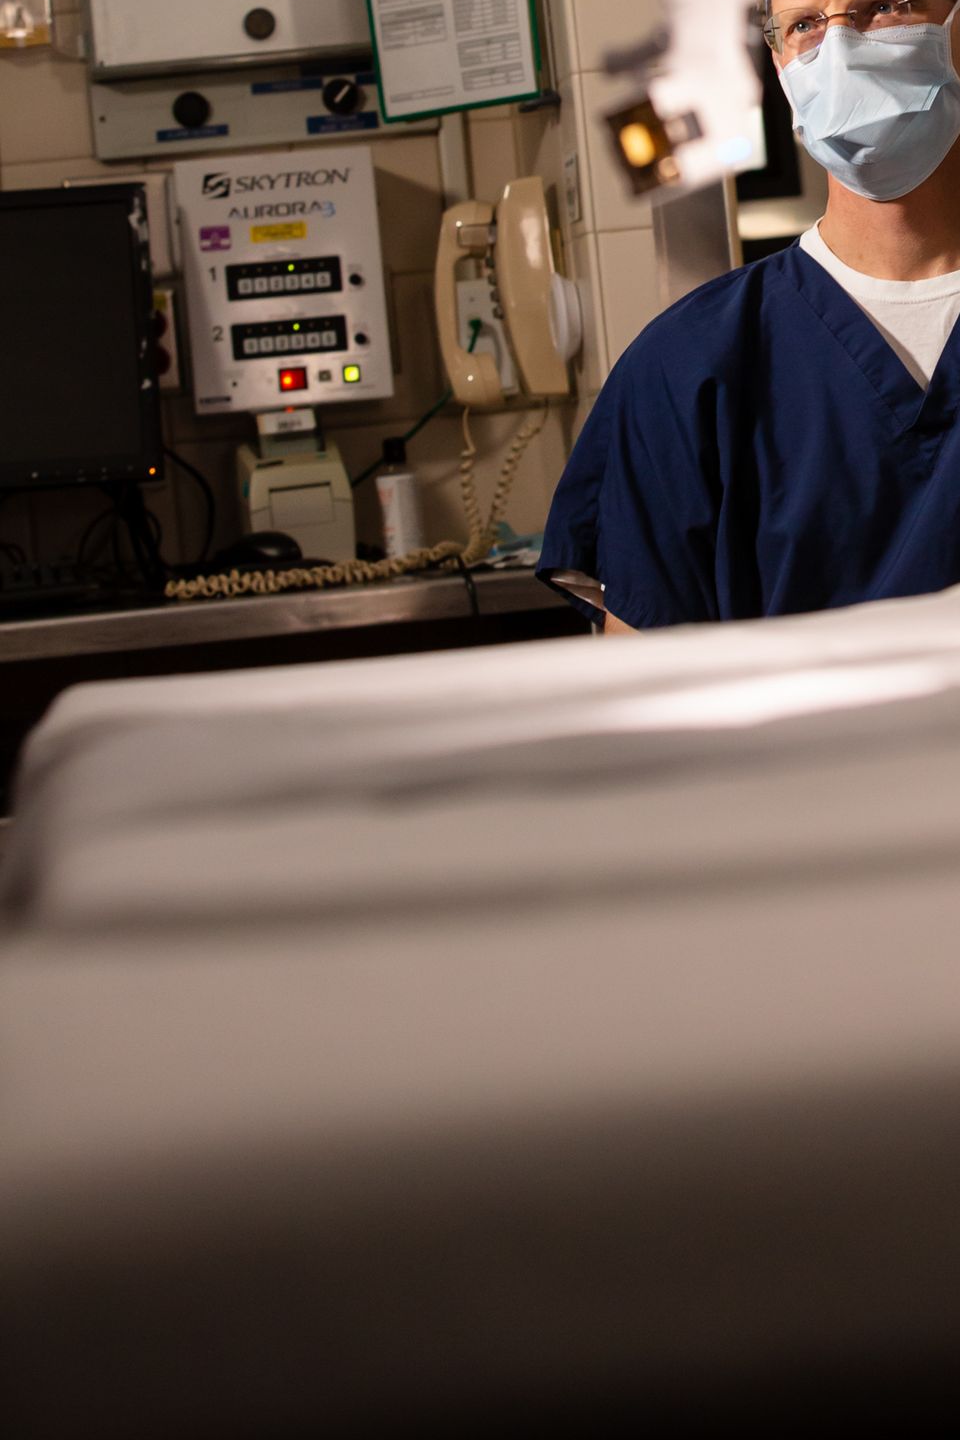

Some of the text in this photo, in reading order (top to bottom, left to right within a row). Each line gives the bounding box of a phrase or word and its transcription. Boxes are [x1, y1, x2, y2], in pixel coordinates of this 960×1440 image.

[234, 168, 351, 193] SKYTRON
[209, 267, 216, 281] 1
[212, 327, 223, 342] 2
